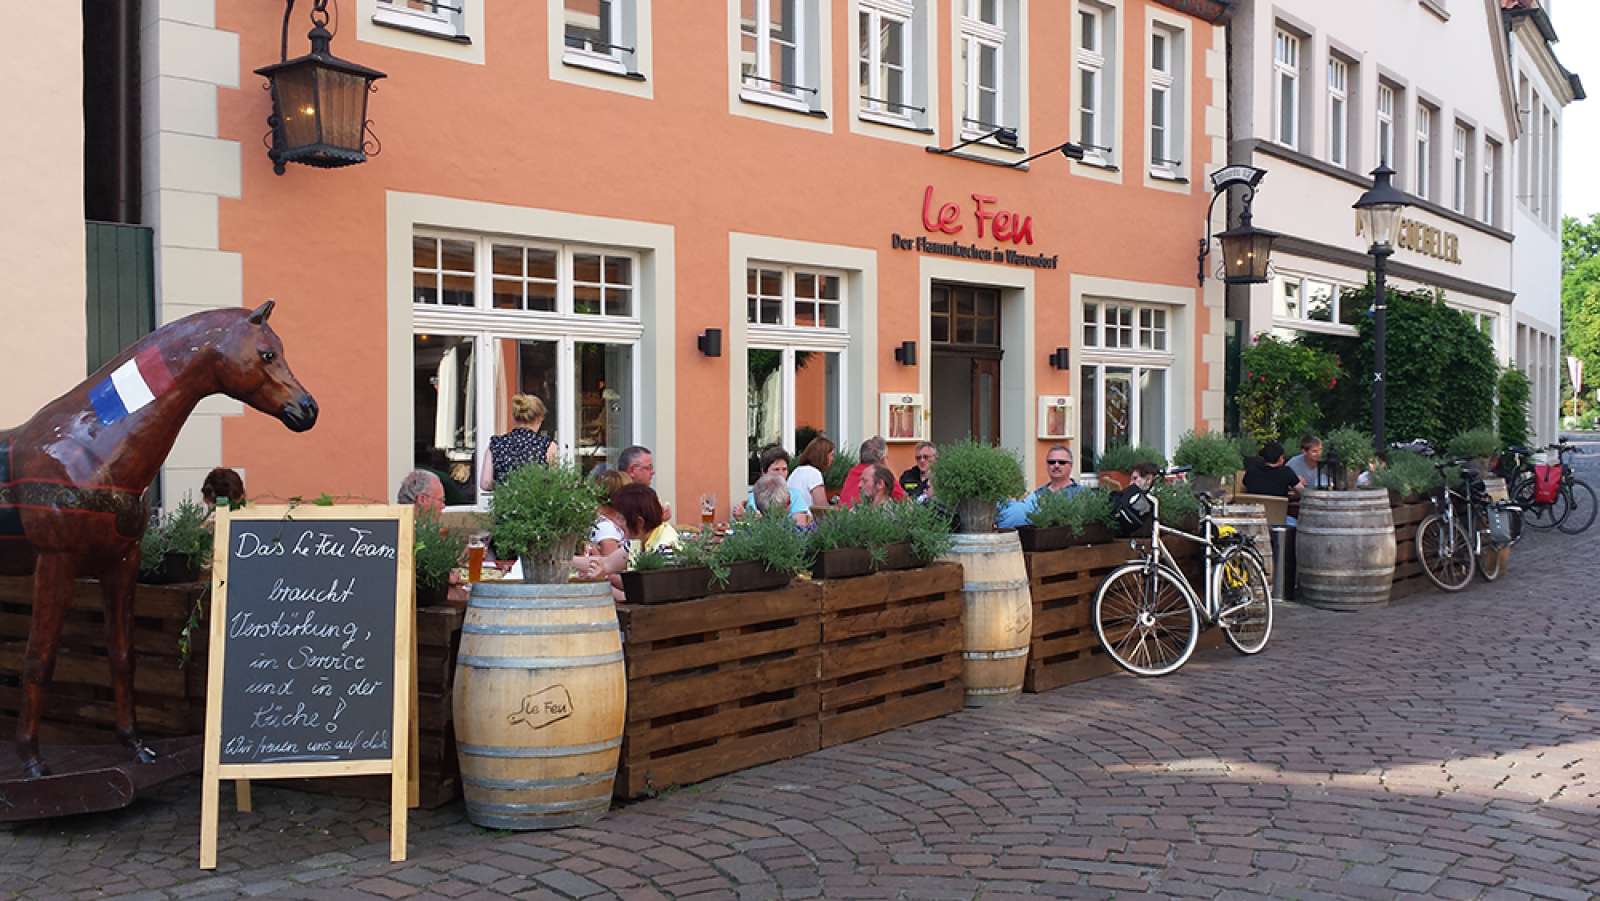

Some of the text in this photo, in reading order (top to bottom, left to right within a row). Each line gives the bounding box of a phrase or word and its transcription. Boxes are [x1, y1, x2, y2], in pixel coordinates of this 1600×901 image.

[970, 192, 1034, 245] Feu
[891, 232, 1059, 269] Der Flammkuchen in Warendorf
[235, 532, 284, 558] Das
[315, 532, 346, 558] Feu
[349, 527, 396, 559] Team
[268, 577, 356, 603] braucht
[230, 609, 372, 650] Verstärkung,
[250, 646, 367, 671] im Service
[245, 676, 384, 697] und in der
[544, 700, 567, 715] Feu
[306, 741, 332, 752] uns
[335, 730, 362, 753] auf
